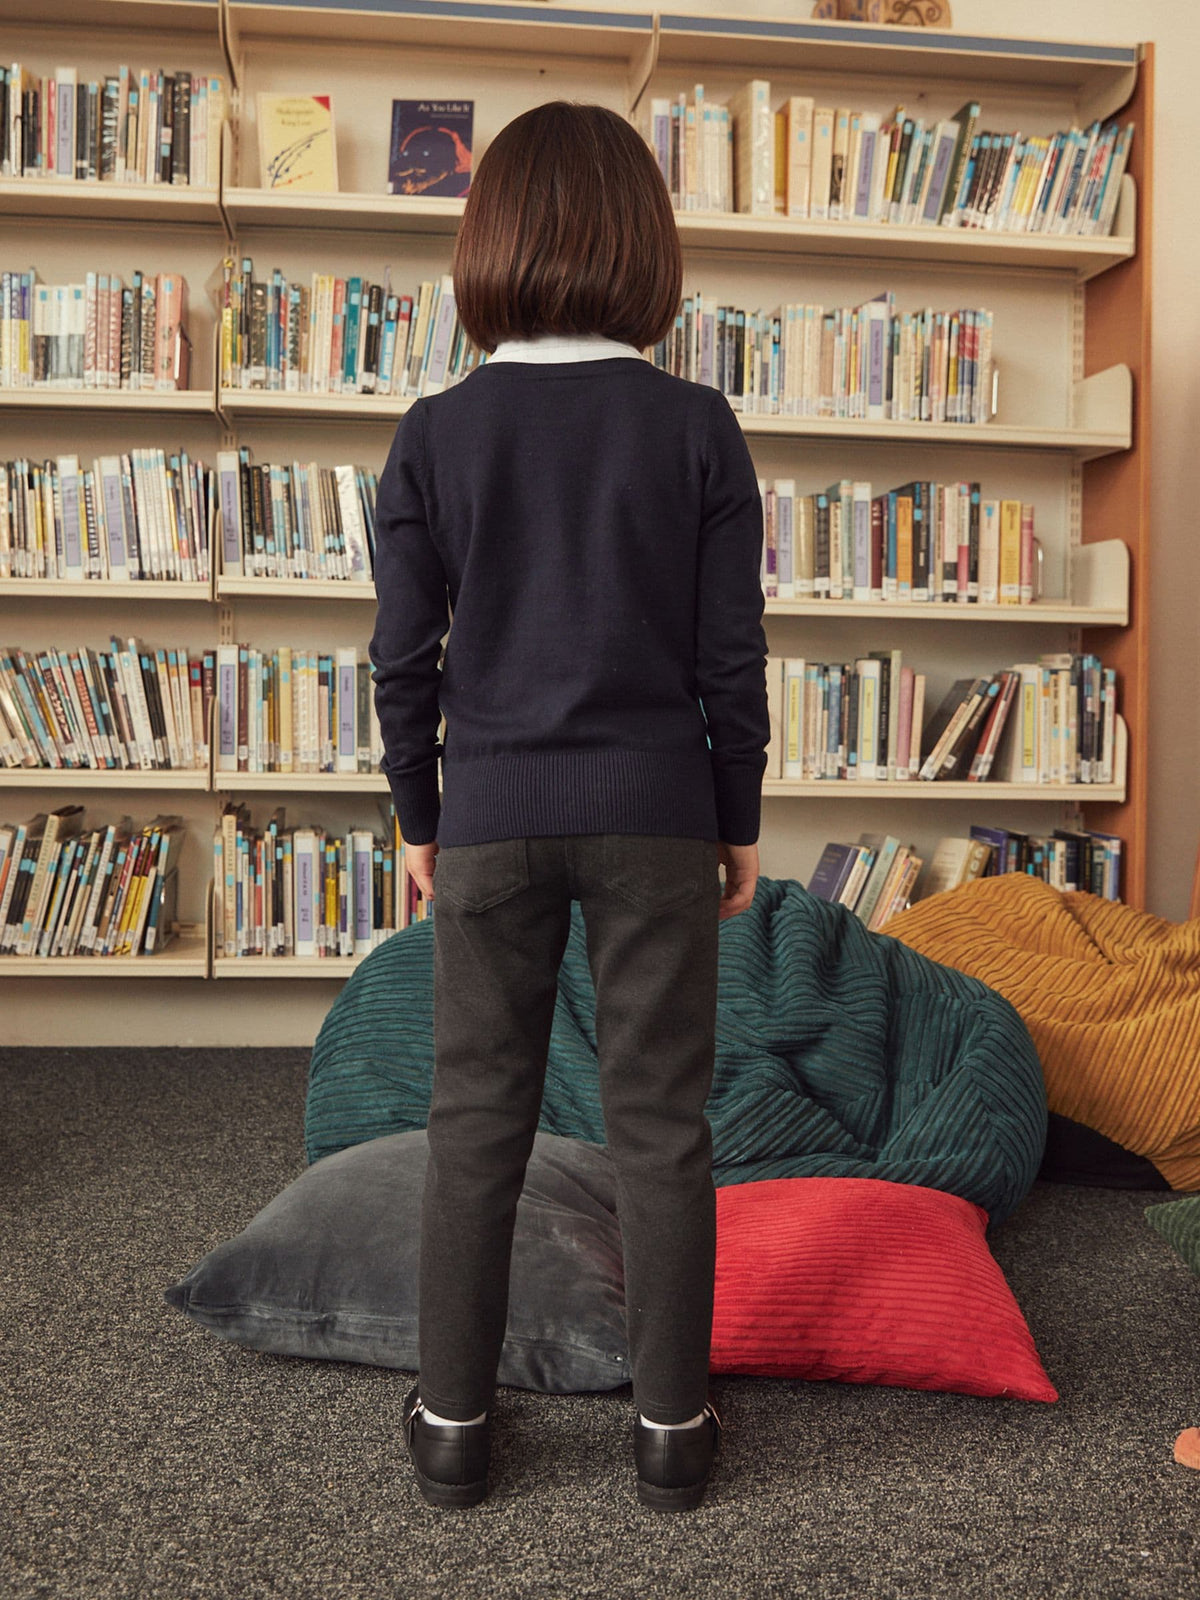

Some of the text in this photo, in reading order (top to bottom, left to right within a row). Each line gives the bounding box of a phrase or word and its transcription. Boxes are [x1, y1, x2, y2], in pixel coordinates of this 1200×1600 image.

[418, 103, 470, 112] As You Like It
